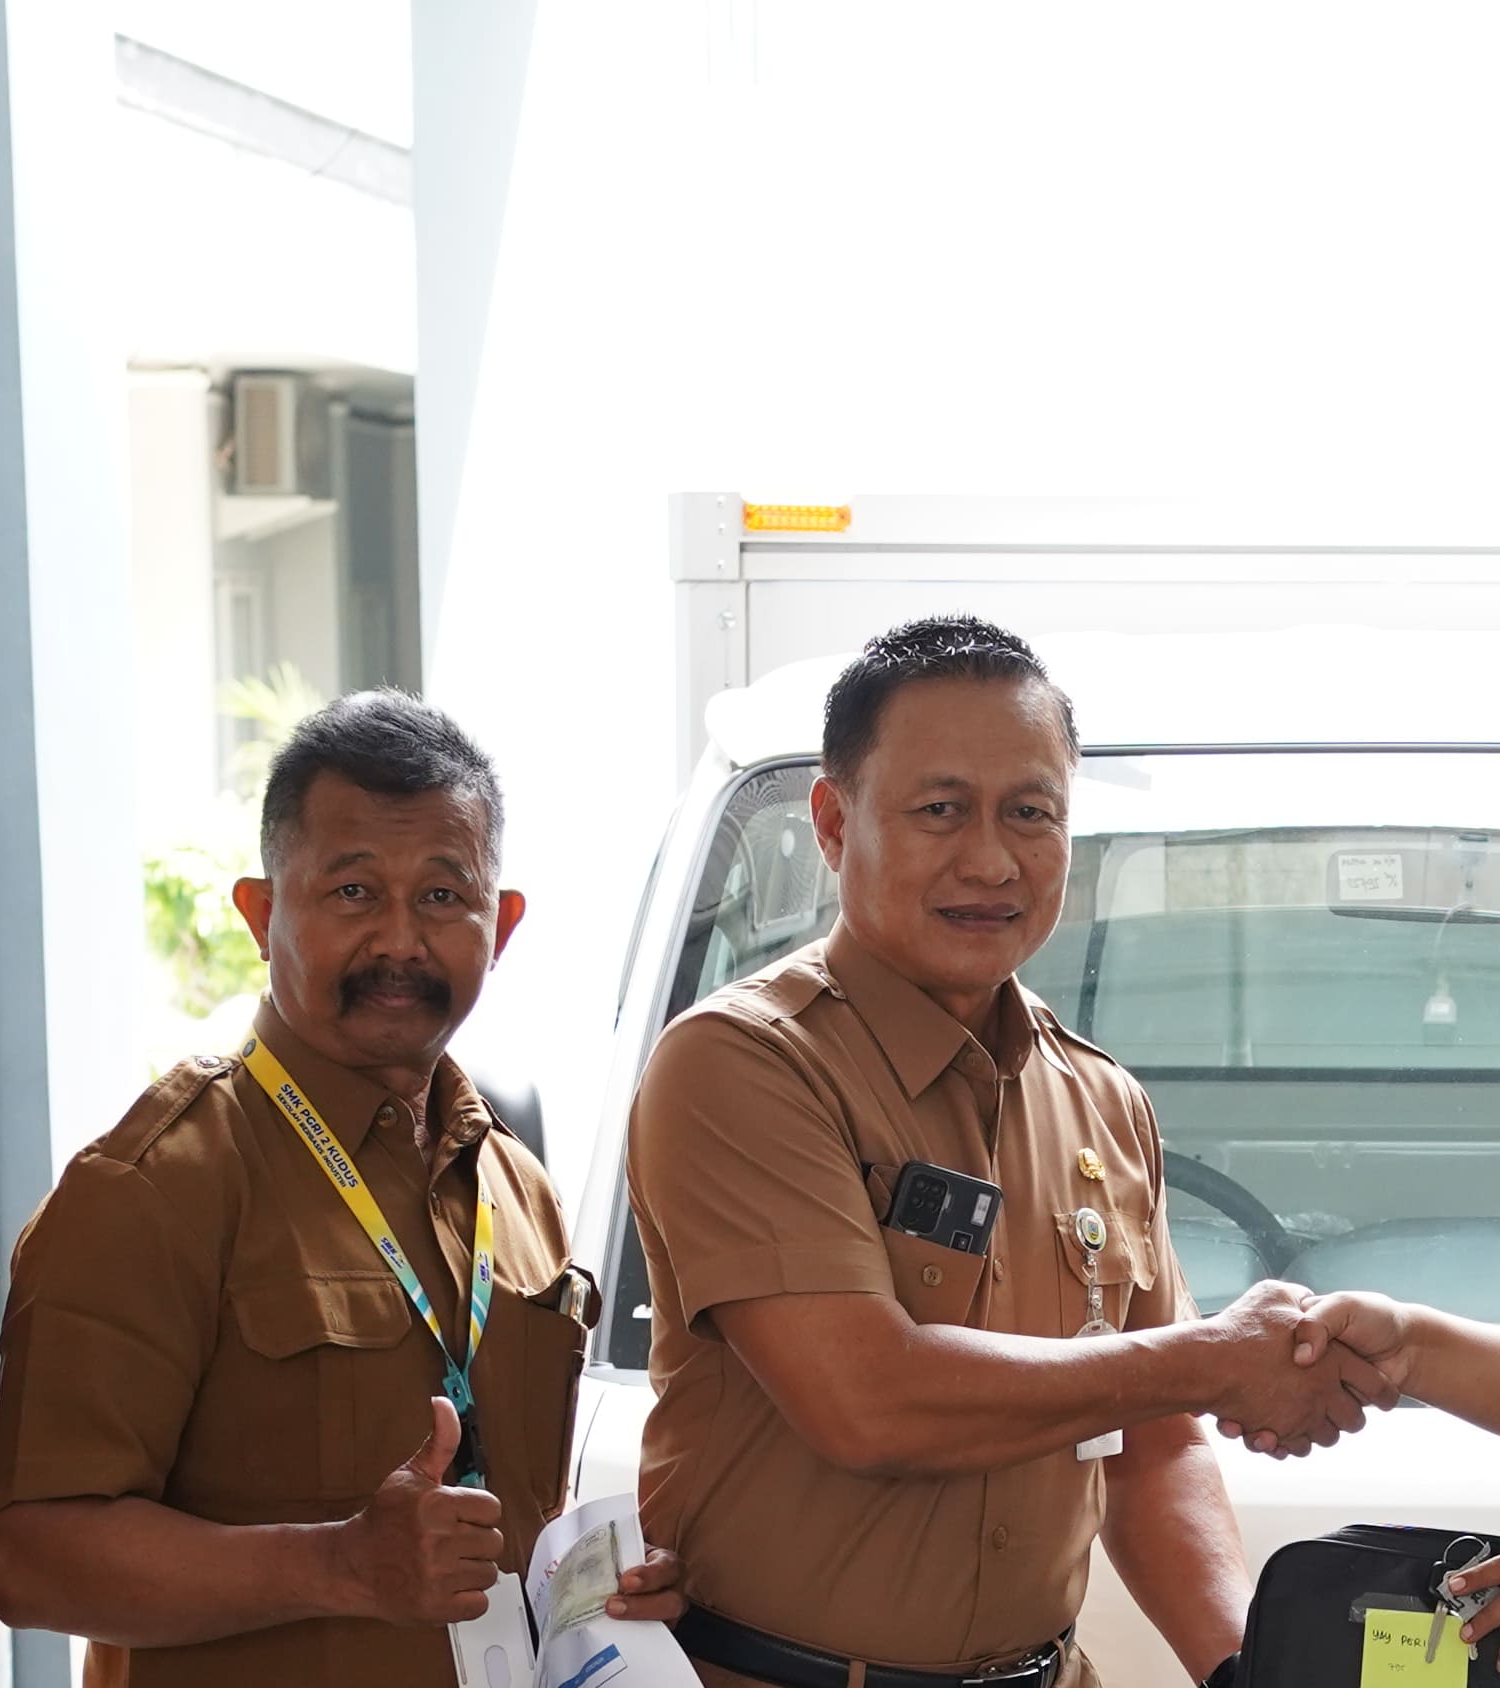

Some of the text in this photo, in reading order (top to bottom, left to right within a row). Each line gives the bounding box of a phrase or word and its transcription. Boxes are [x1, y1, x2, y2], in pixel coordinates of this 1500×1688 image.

[281, 1084, 359, 1188] SMK PGRI 2 KUDUS
